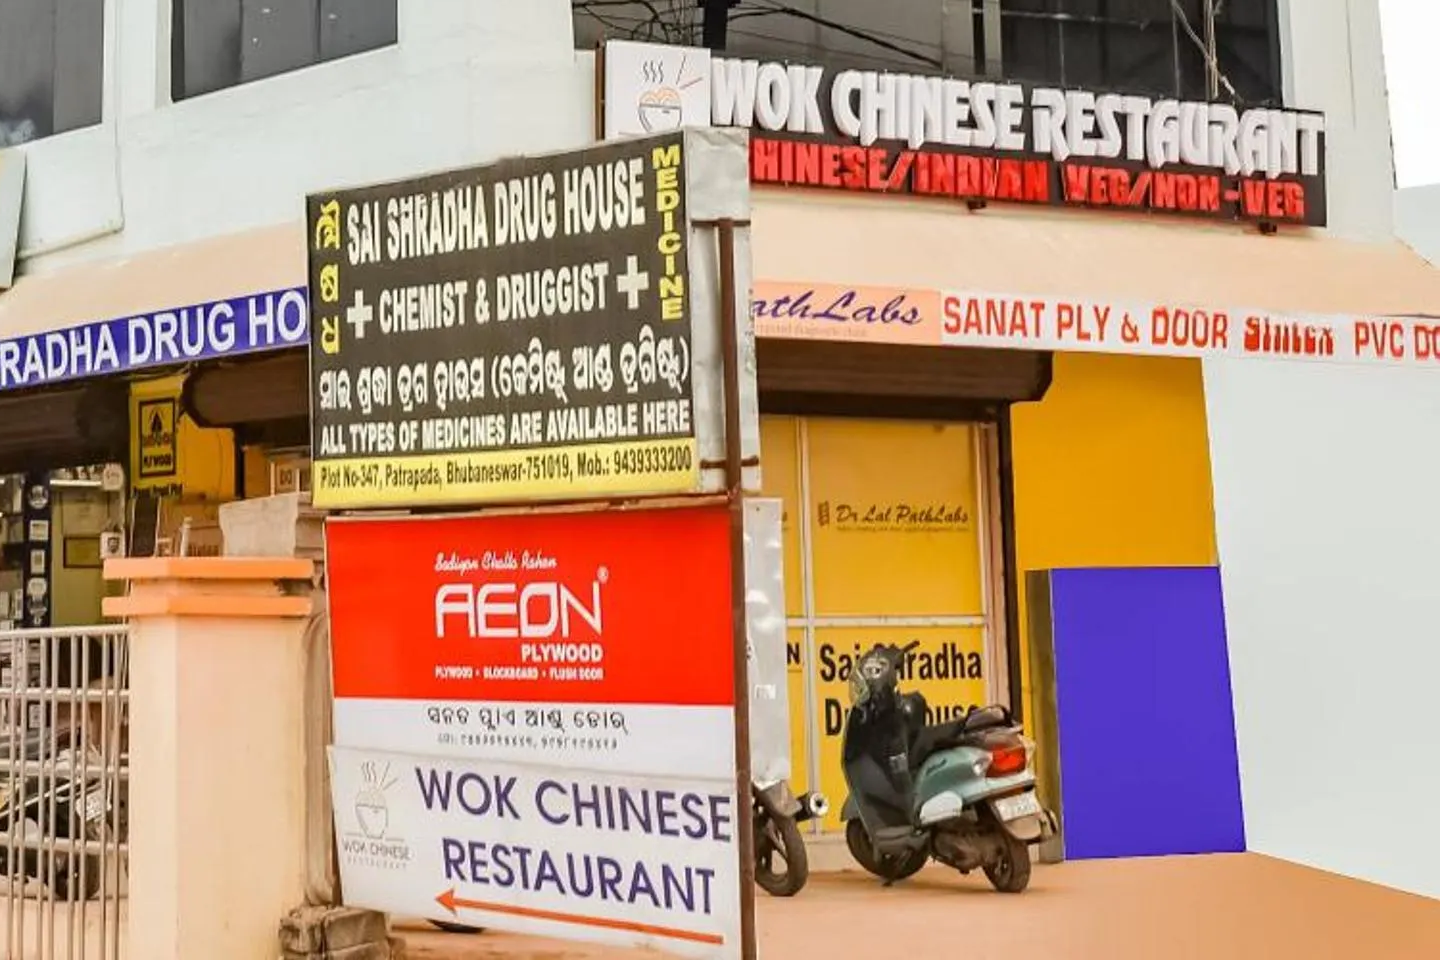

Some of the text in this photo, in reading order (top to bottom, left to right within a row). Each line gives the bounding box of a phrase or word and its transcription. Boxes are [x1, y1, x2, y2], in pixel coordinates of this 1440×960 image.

[711, 57, 1325, 179] WOK CHINESE RESTAURANT
[749, 137, 1050, 202] HINESE/INDIAN
[346, 157, 646, 266] SAI SHRADHA DRUG HOUSE
[651, 144, 684, 320] MEDICINE
[379, 262, 609, 334] CHEMIST & DRUGGIST
[751, 290, 923, 326] athLabs
[943, 296, 1228, 349] SANAT PLY & DOOR
[128, 302, 235, 367] DRUG
[1354, 320, 1405, 359] PVC
[320, 399, 690, 455] ALL TYPES OF MEDICINES ARE AVAILABLE HERE
[320, 466, 341, 489] Plot
[343, 464, 383, 491] No-347,
[385, 461, 442, 491] Patrapada,
[614, 445, 692, 475] 9439333200
[835, 504, 968, 525] Dr Lal PathLabs
[435, 581, 602, 638] AEON
[520, 643, 604, 662] PLYWOOD
[416, 768, 732, 843] WOK CHINESE
[442, 838, 715, 915] RESTAURANT
